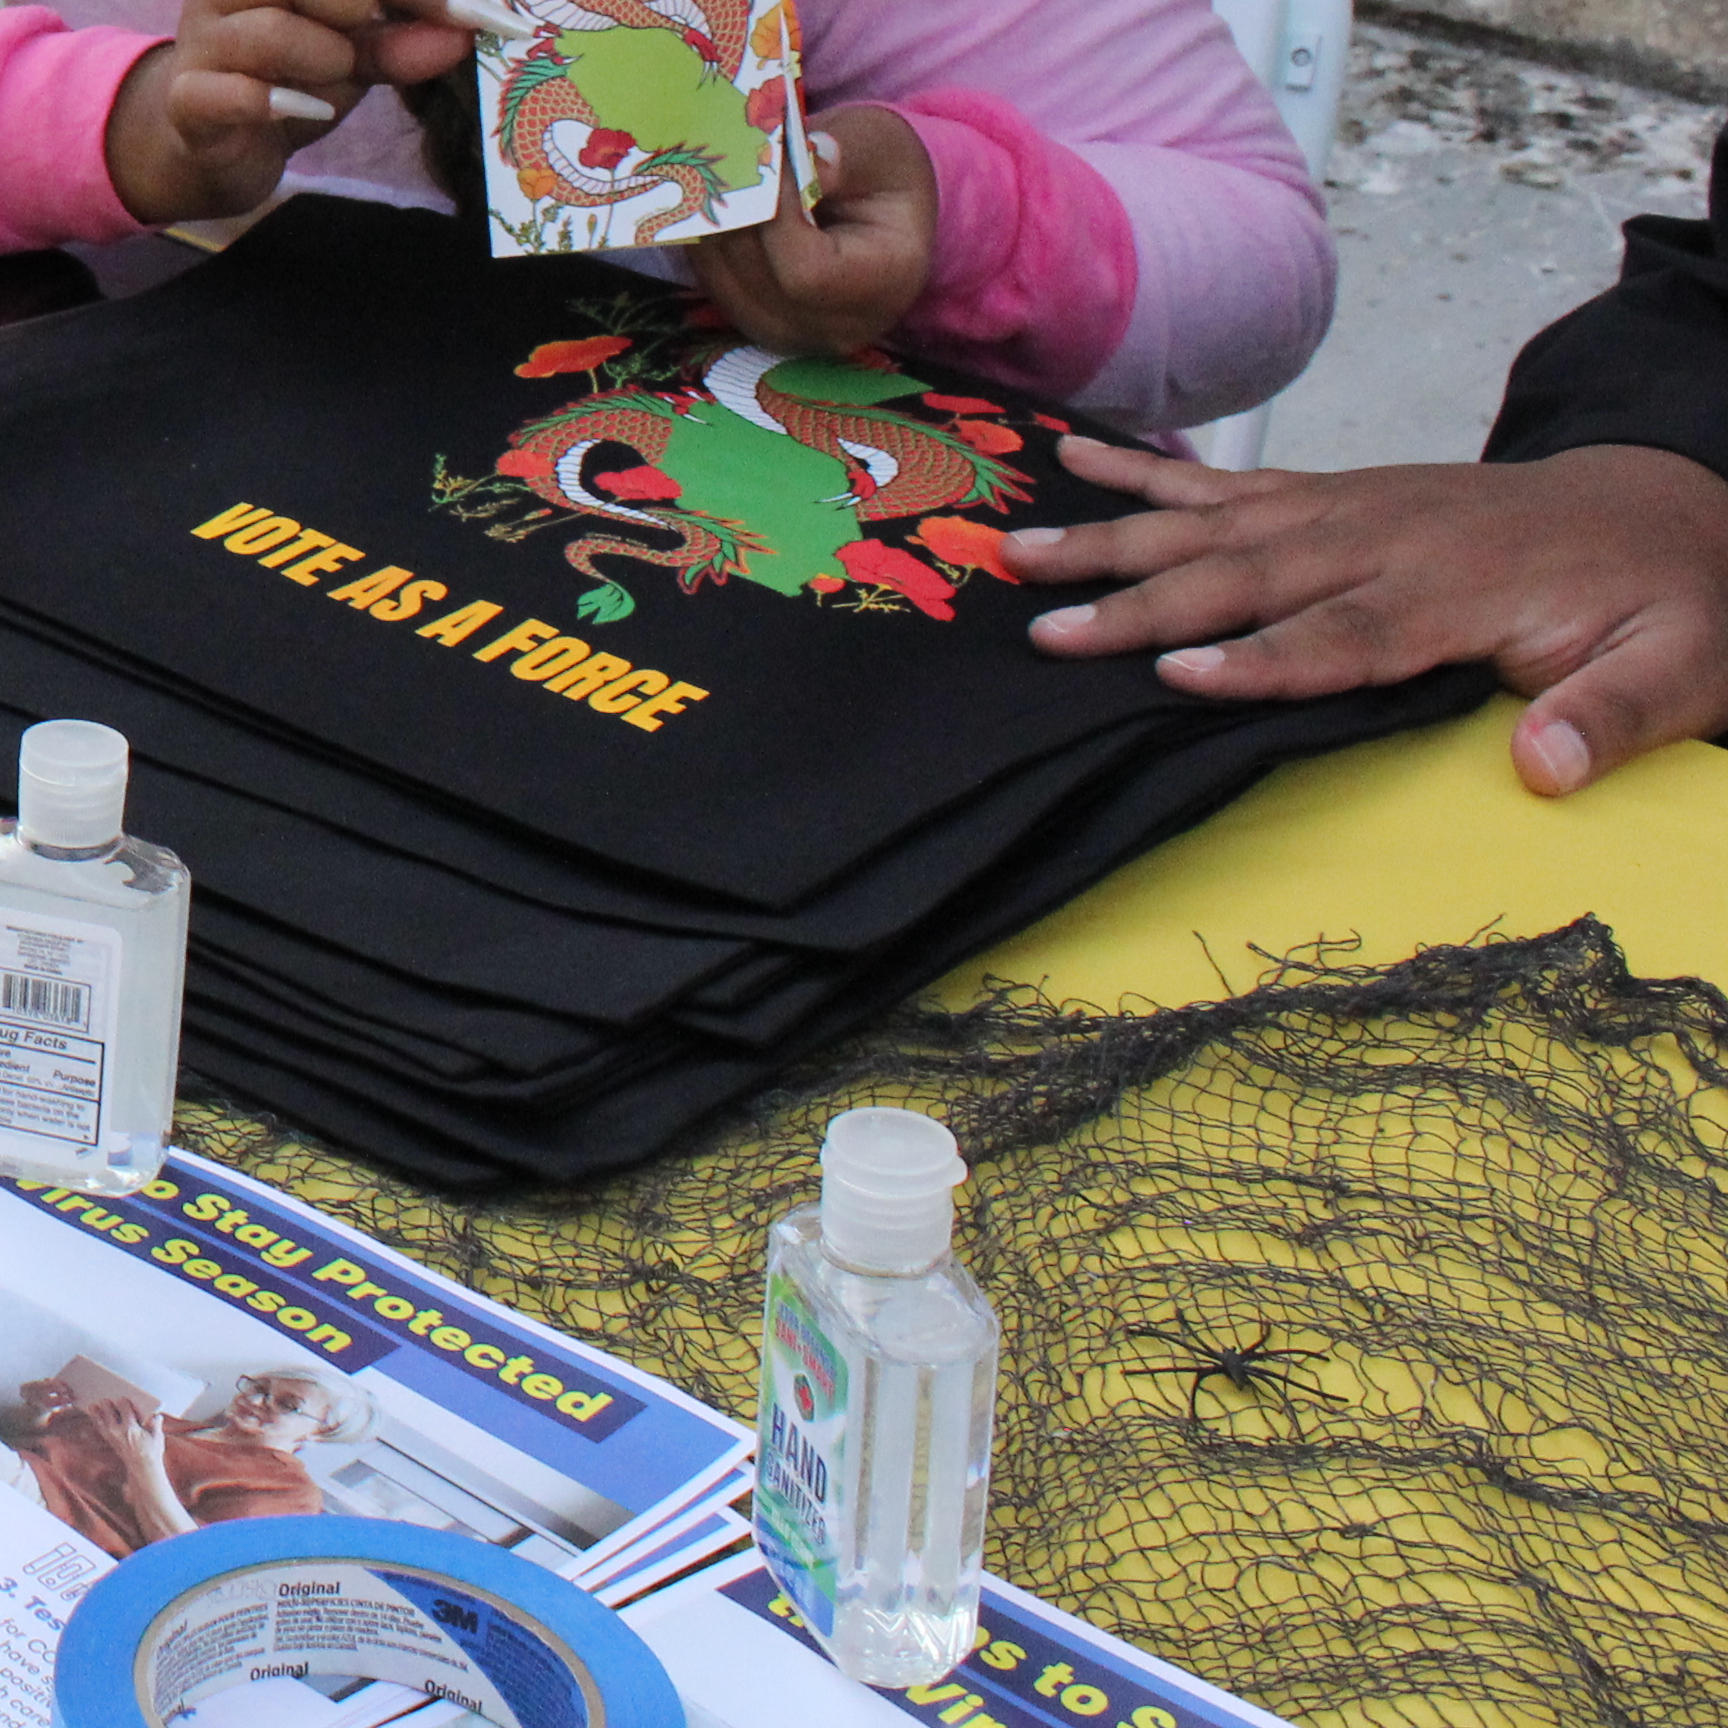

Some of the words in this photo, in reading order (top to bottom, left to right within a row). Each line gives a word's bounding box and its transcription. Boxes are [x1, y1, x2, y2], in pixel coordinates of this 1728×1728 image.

[189, 501, 366, 587] VOTE
[326, 565, 450, 622] AS
[414, 598, 504, 648] A
[472, 617, 711, 733] FORCE
[24, 1031, 67, 1050] Facts
[53, 1069, 96, 1087] Purpose
[150, 1238, 353, 1354] Season
[182, 1192, 314, 1269] Stay
[312, 1257, 614, 1424] Protected
[772, 1402, 826, 1506] HAND
[766, 1449, 826, 1547] SANITIZER
[278, 1580, 340, 1598] Original
[432, 1598, 479, 1634] 3M
[250, 1661, 309, 1682] Original
[1033, 1661, 1109, 1716] to
[9, 1697, 51, 1728] care
[424, 1679, 483, 1714] Original
